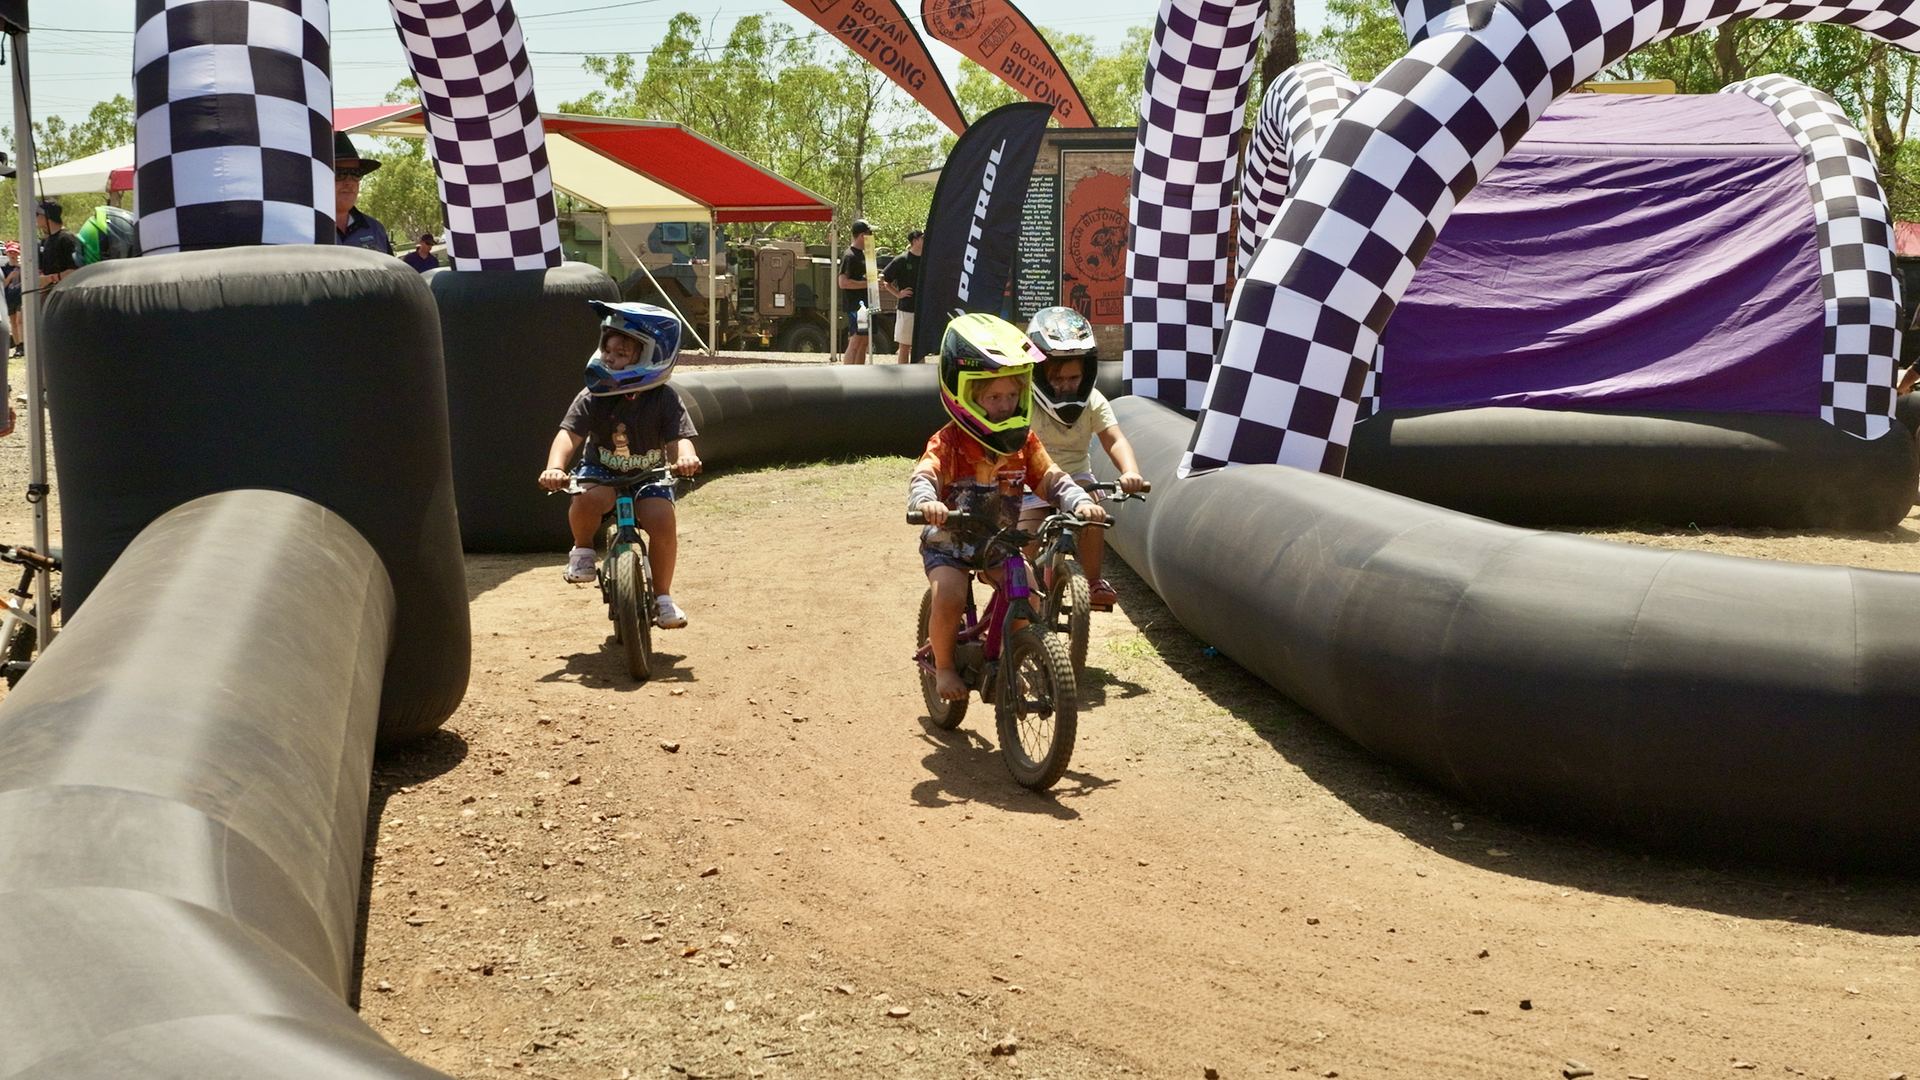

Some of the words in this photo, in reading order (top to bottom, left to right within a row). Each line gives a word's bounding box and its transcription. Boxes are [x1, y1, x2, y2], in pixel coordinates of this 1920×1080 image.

[851, 0, 908, 45] BOGAN
[837, 14, 927, 90] BILTONG
[1010, 41, 1057, 80] BOGAN
[1000, 56, 1073, 118] BILTONG
[957, 139, 1006, 303] PATROL
[598, 446, 661, 472] WAYFINDER
